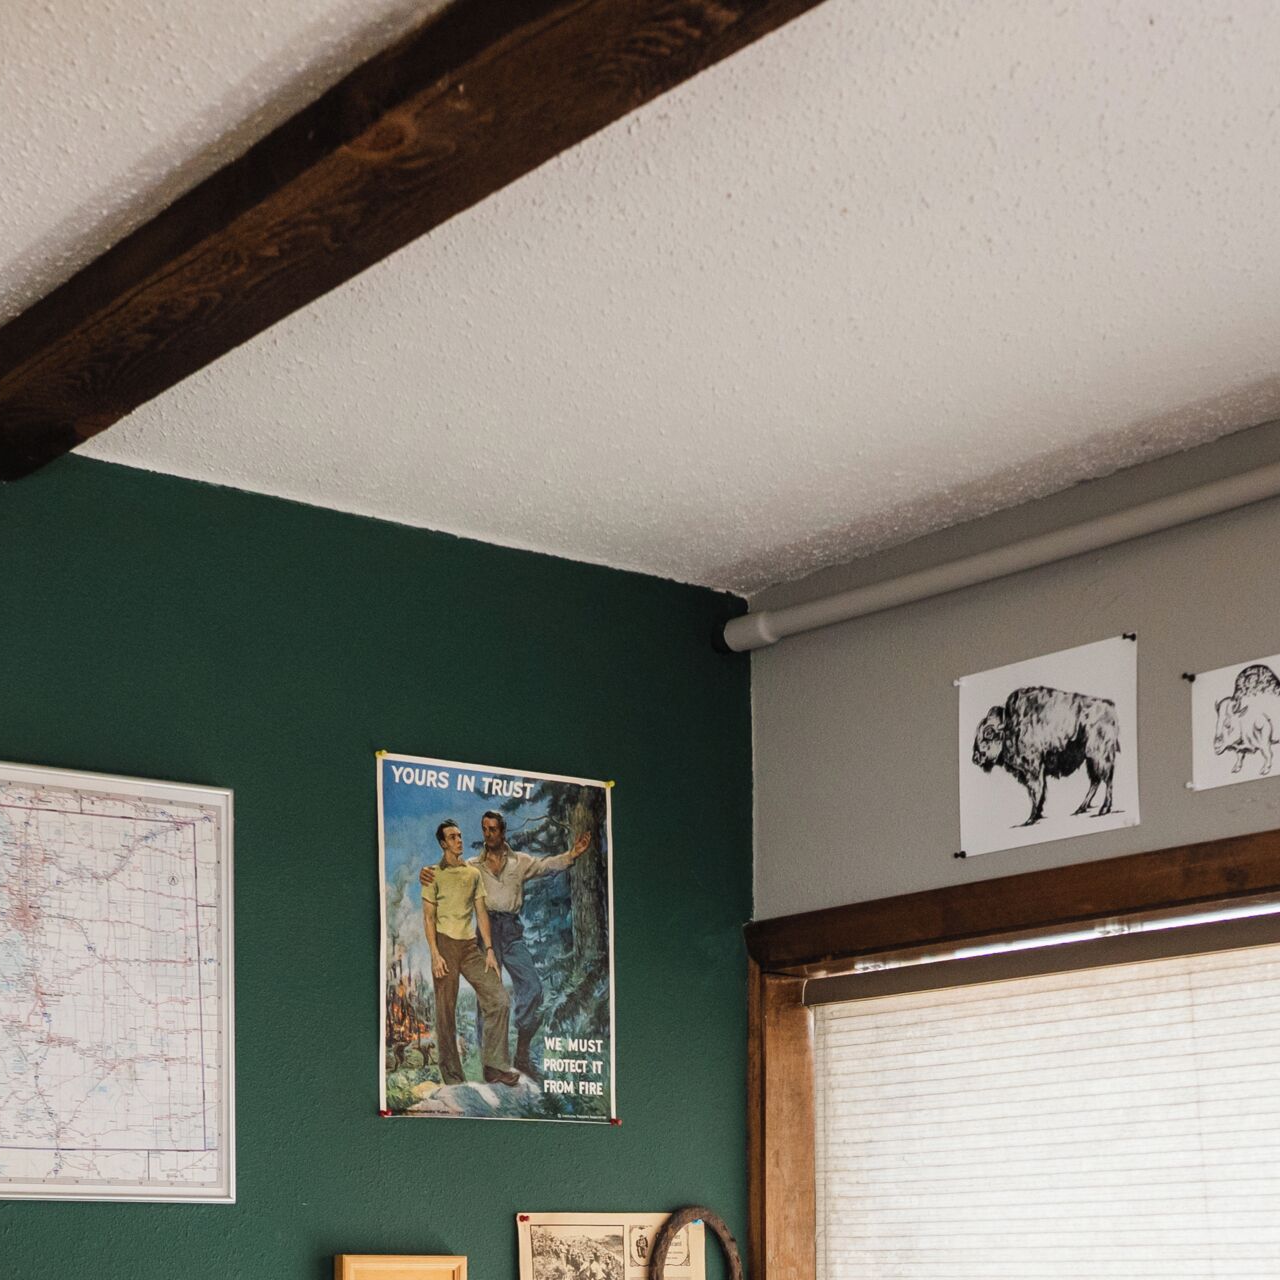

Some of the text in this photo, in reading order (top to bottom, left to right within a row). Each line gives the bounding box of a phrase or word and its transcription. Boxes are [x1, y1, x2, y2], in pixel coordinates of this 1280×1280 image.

[391, 765, 535, 800] YOURS IN TRUST
[544, 1036, 603, 1053] WE MUST
[543, 1058, 603, 1074] PROTECT IT
[543, 1080, 603, 1095] FROM FIRE
